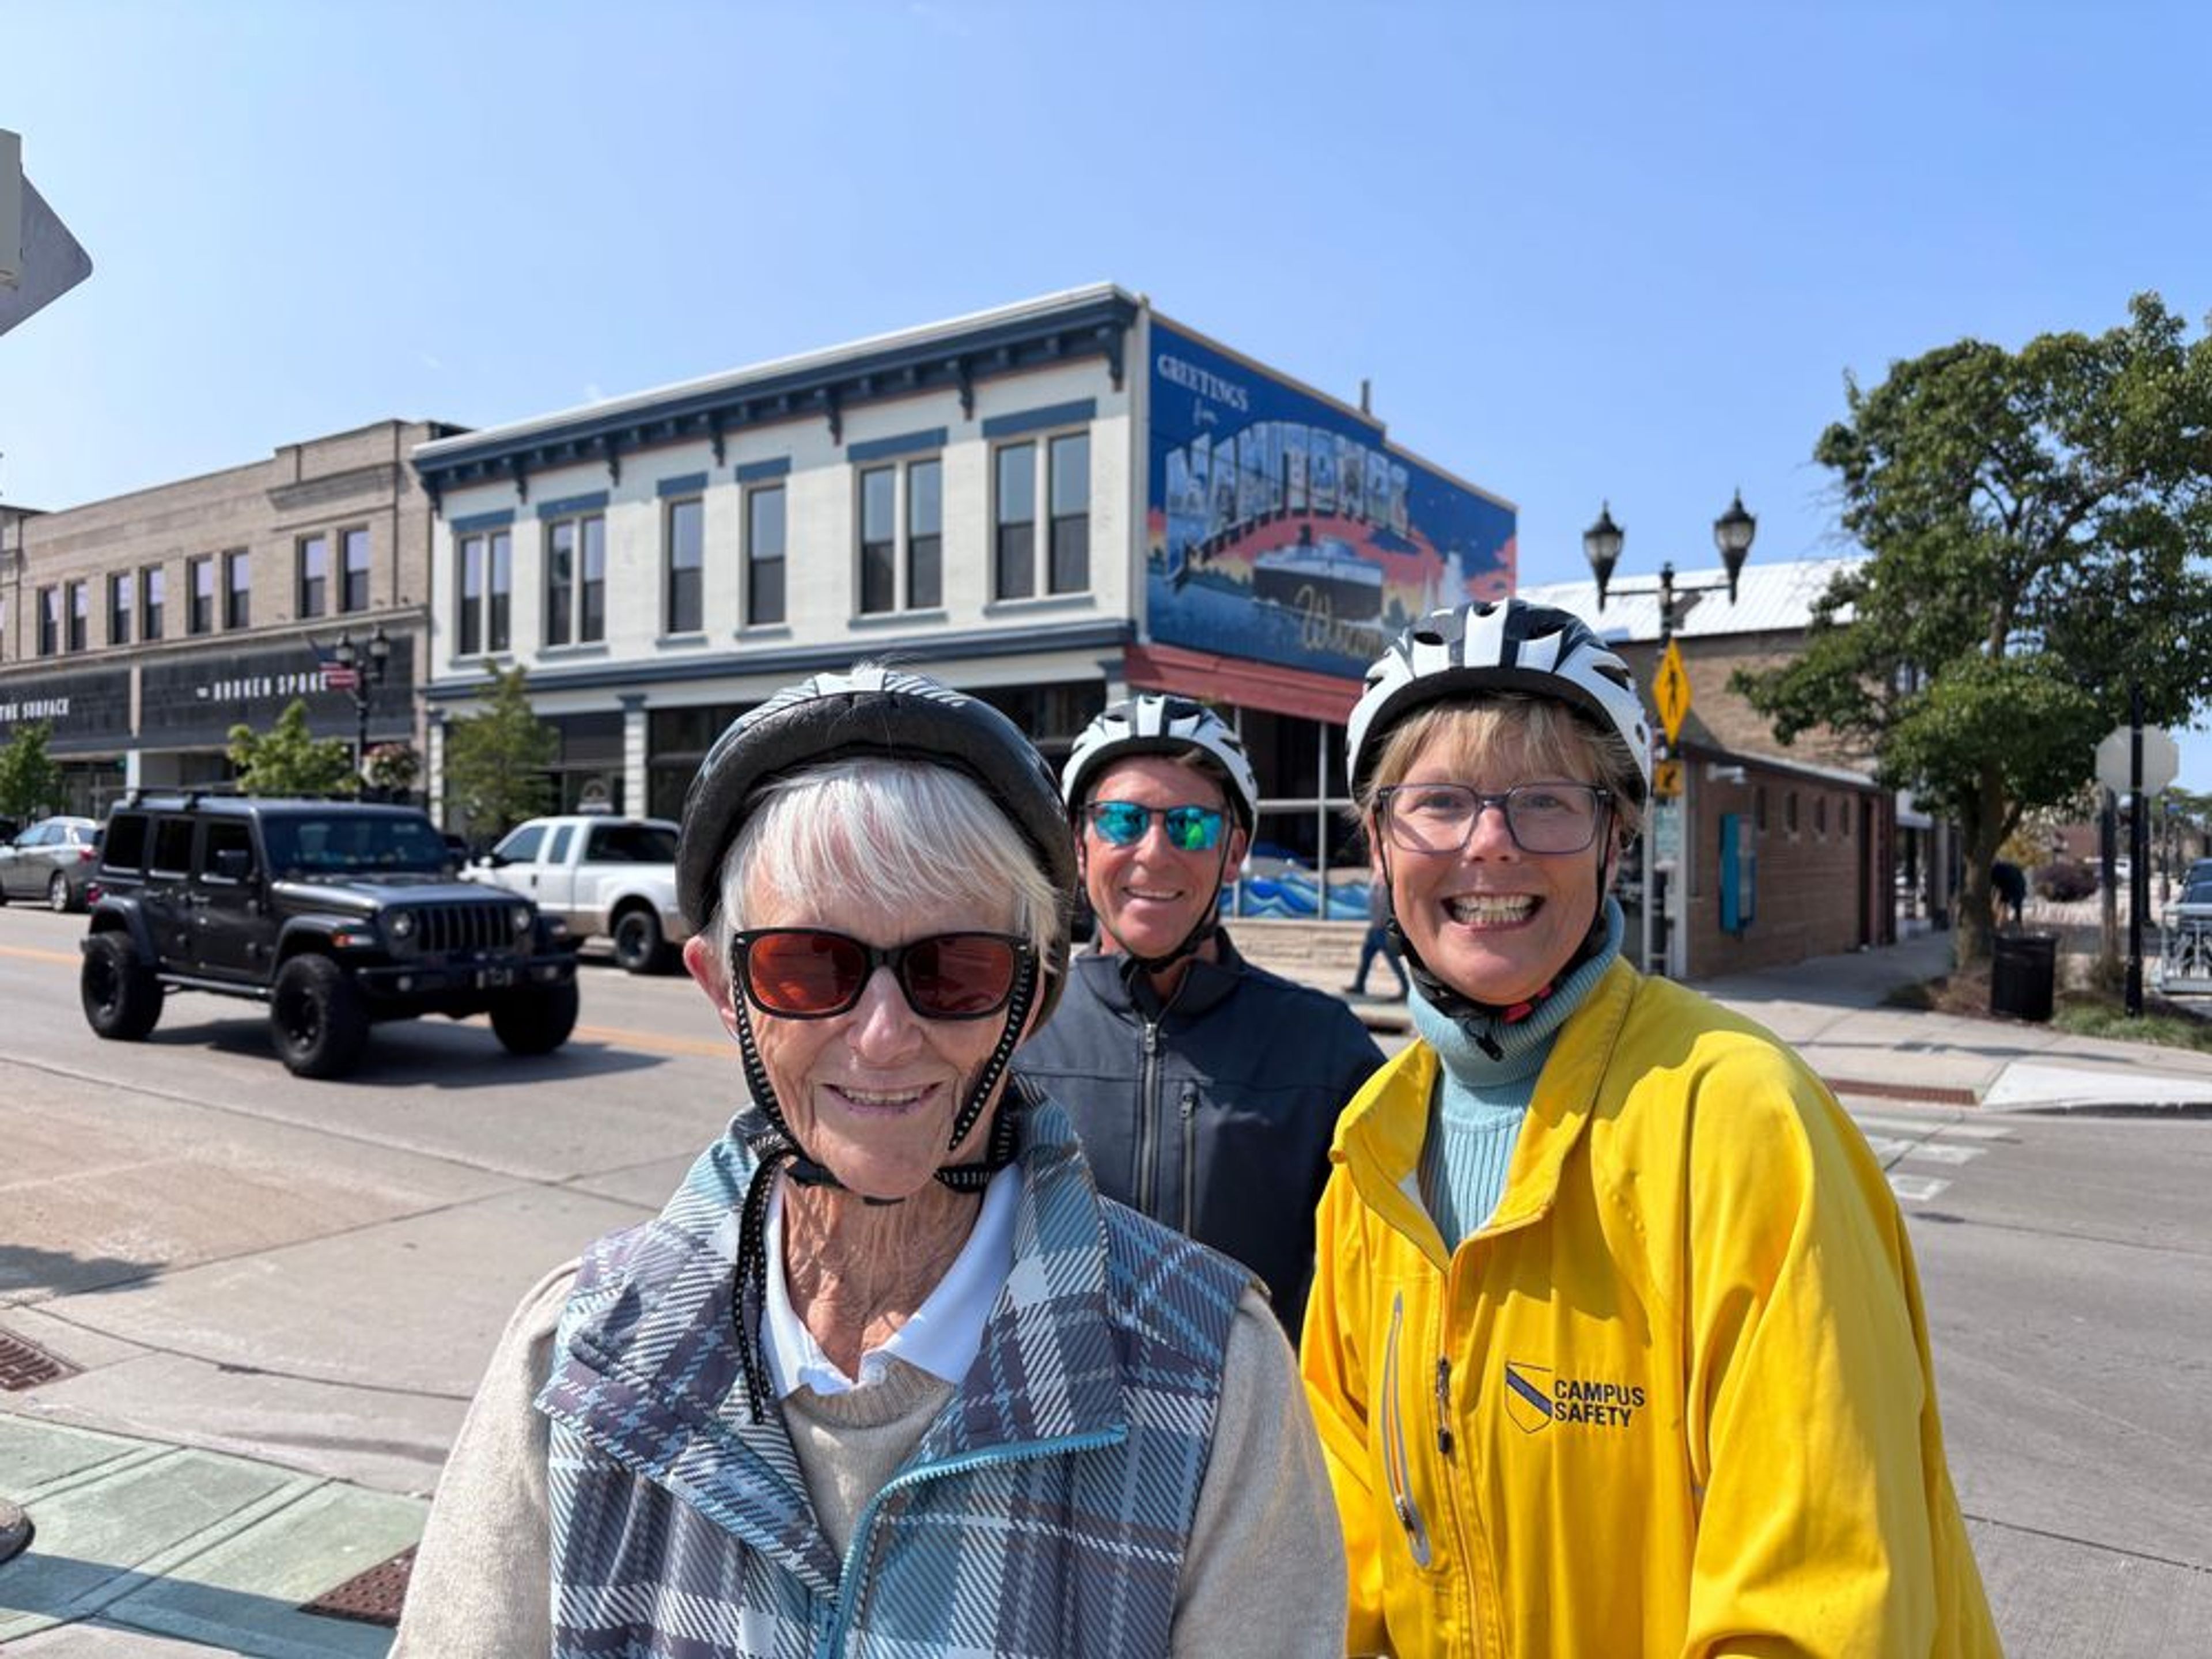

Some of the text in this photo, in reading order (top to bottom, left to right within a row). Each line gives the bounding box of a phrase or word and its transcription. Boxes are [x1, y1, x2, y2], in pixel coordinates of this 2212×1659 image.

[1157, 354, 1249, 412] GREETINGS
[277, 672, 328, 695] SPOKE
[1554, 1380, 1645, 1407] CAMPUS
[1555, 1401, 1632, 1427] SAFETY
